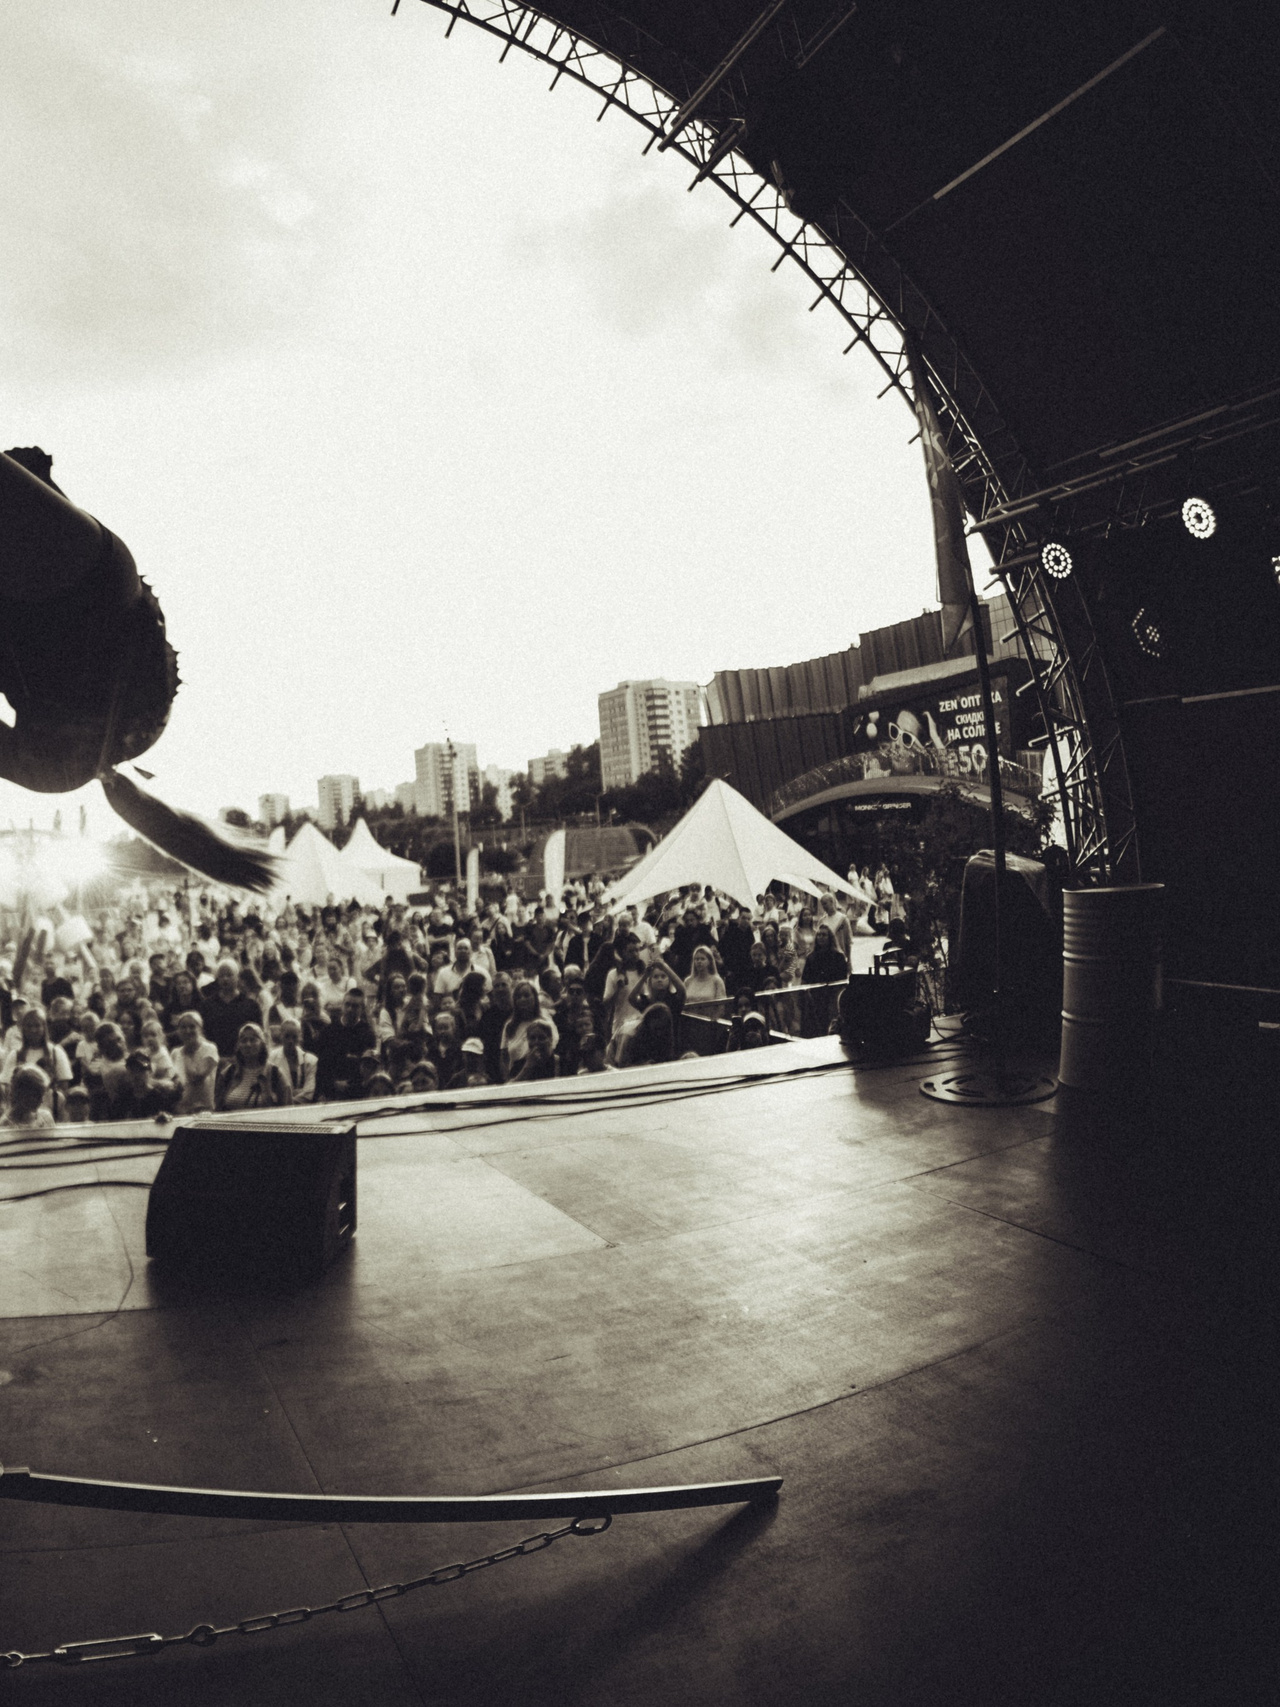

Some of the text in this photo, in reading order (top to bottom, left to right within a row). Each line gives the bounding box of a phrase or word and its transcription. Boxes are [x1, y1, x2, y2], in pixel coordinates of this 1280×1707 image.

[938, 690, 1003, 713] ZEN ОПТКА
[947, 727, 962, 741] НА
